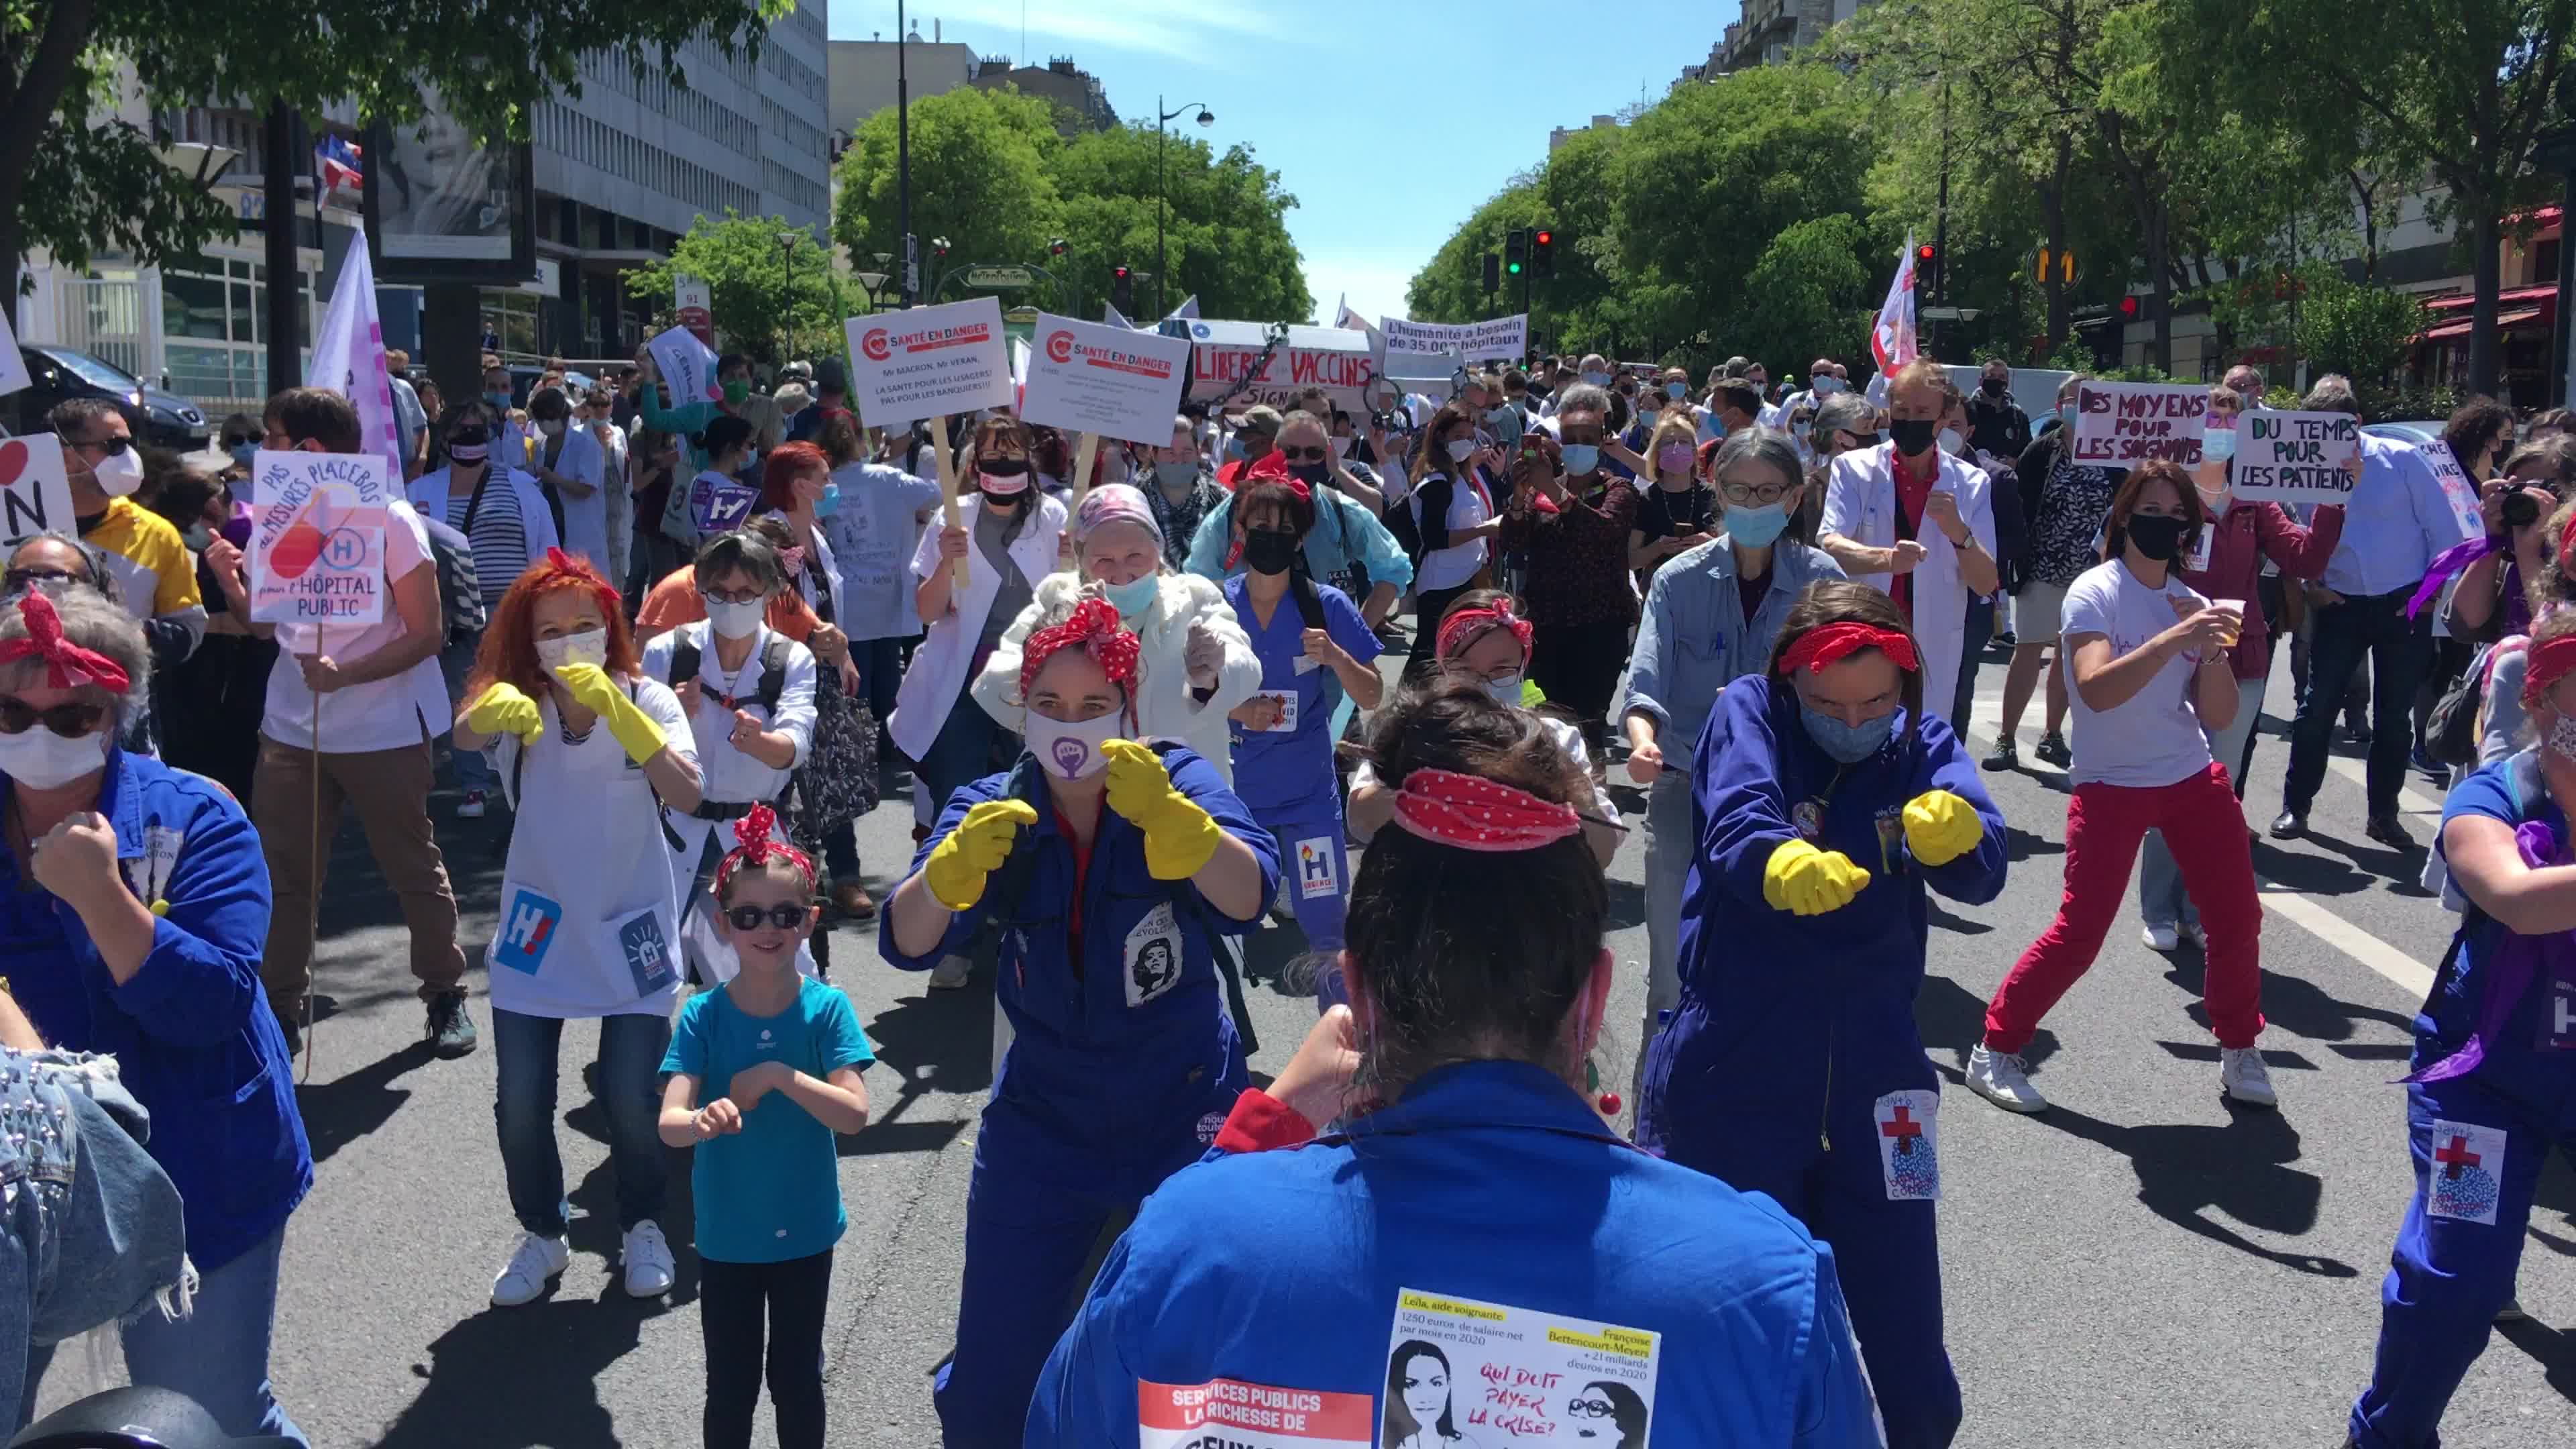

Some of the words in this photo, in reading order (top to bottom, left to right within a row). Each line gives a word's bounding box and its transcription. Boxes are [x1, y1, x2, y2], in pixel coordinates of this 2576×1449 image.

[891, 333, 926, 347] SANTÉ
[928, 330, 943, 341] EN
[945, 323, 988, 339] DANGER
[1388, 322, 1461, 339] L'humanité
[1466, 330, 1473, 338] a
[1477, 319, 1521, 335] besoin
[1389, 337, 1406, 348] de
[1410, 339, 1426, 350] 35
[1461, 335, 1519, 350] hôpitaux
[1074, 344, 1110, 360] SANTÉ
[1112, 351, 1126, 362] EN
[1128, 354, 1173, 371] DANGER
[875, 386, 886, 395] LA
[914, 379, 938, 389] POUR
[938, 376, 952, 386] LES
[880, 396, 896, 406] PAS
[897, 392, 921, 404] POUR
[922, 389, 936, 399] LES
[2080, 387, 2112, 414] DES
[2117, 392, 2208, 419] MOYENS
[2114, 418, 2172, 437] POUR
[2251, 418, 2282, 440] DU
[2294, 418, 2358, 441] TEMPS
[2074, 437, 2116, 460] LES
[2273, 440, 2327, 463] POUR
[261, 464, 290, 490] PAS
[307, 460, 381, 503] PLACEBOS
[2241, 465, 2274, 487] LES
[2279, 464, 2355, 492] PATIENTS
[261, 477, 313, 535] MESURES
[259, 535, 274, 549] de
[333, 539, 352, 561] H
[297, 598, 360, 617] PUBLIC
[1431, 1300, 1452, 1312] aide
[1454, 1303, 1503, 1322] soignante
[1399, 1324, 1416, 1336] par
[1417, 1327, 1443, 1339] mois
[1444, 1332, 1458, 1341] en
[1458, 1334, 1487, 1346] 2020
[1401, 1311, 1426, 1324] 1250
[1427, 1317, 1455, 1330] euros
[1458, 1320, 1472, 1332] de
[1473, 1323, 1505, 1338] salaire
[1507, 1330, 1524, 1342] net
[1603, 1328, 1652, 1347] Françoise
[1548, 1330, 1650, 1358] Bettencourt-Meyers
[1592, 1351, 1604, 1361] 21
[1605, 1352, 1649, 1370] milliards
[1479, 1362, 1511, 1385] QUI
[1511, 1367, 1565, 1390] DOIT
[1604, 1365, 1619, 1375] en
[1619, 1367, 1648, 1381] 2020
[1172, 1383, 1248, 1407] SERVICES
[1250, 1389, 1321, 1413] PUBLICS
[1485, 1387, 1547, 1417] PAYER
[1184, 1409, 1205, 1426] LA
[1207, 1401, 1281, 1429] RICHESSE
[1283, 1413, 1307, 1431] DE
[1468, 1407, 1487, 1426] LA
[1494, 1413, 1557, 1438] CRISE?
